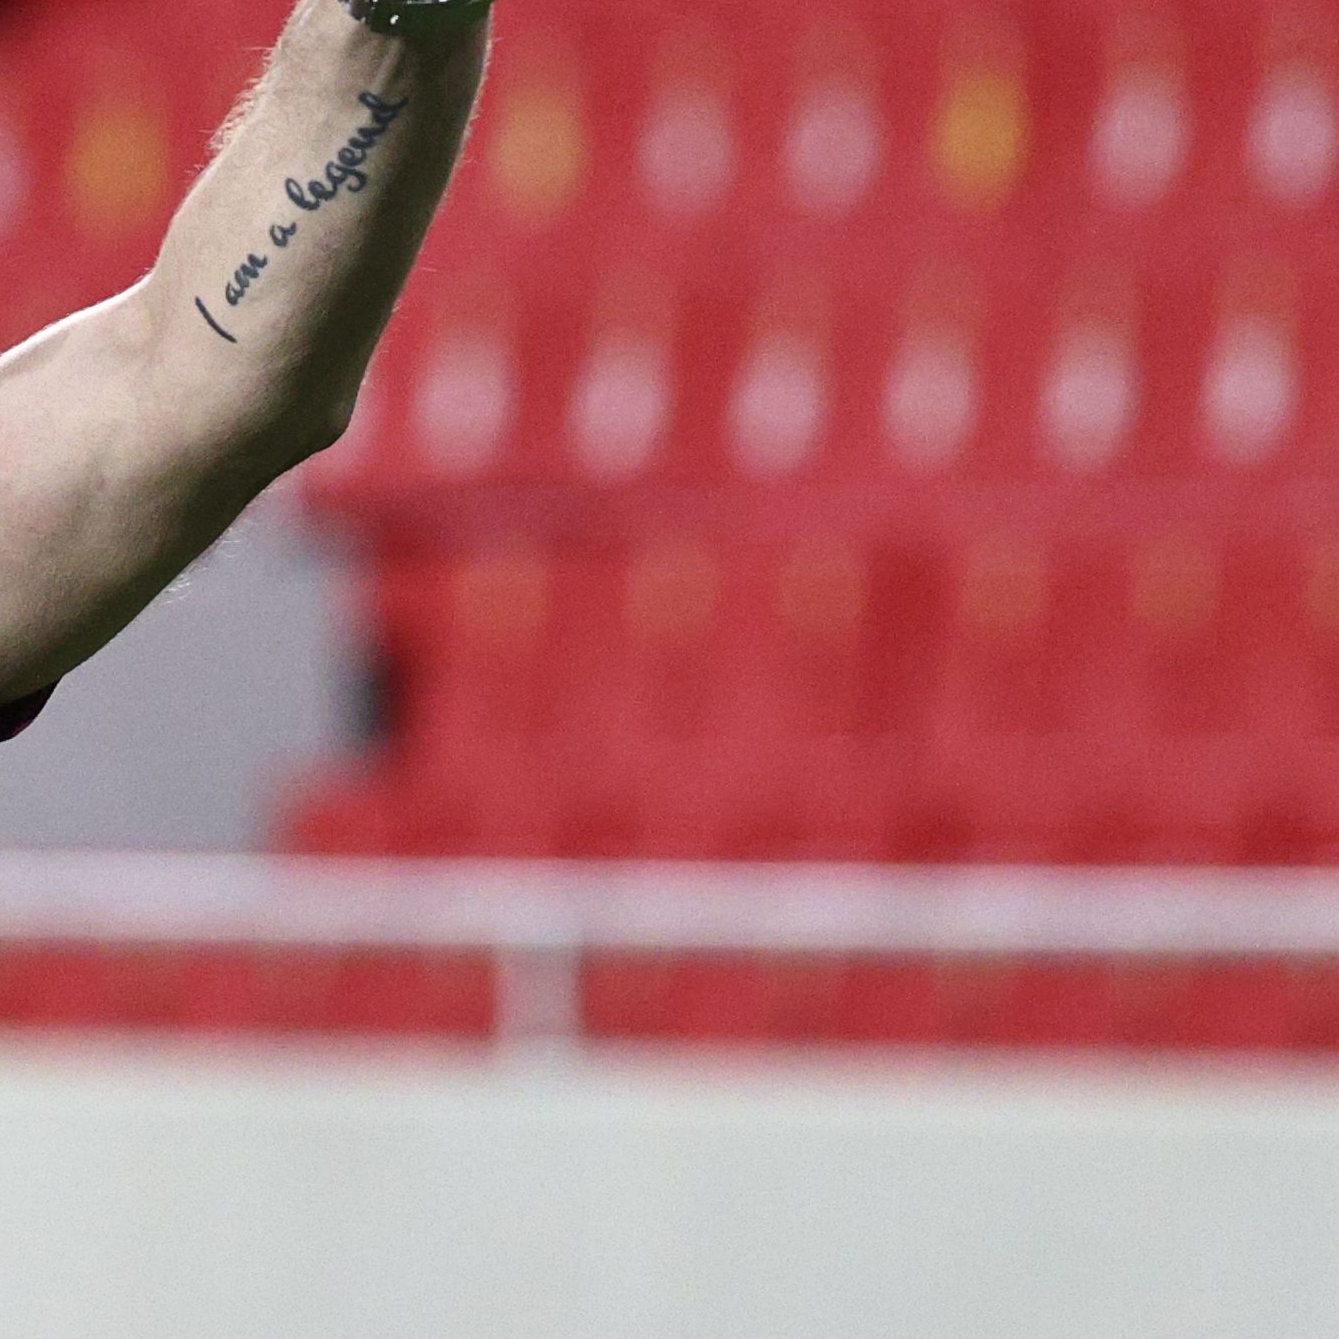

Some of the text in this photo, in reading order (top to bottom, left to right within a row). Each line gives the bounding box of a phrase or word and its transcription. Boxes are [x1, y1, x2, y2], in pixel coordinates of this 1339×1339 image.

[195, 91, 408, 343] I am a legend
